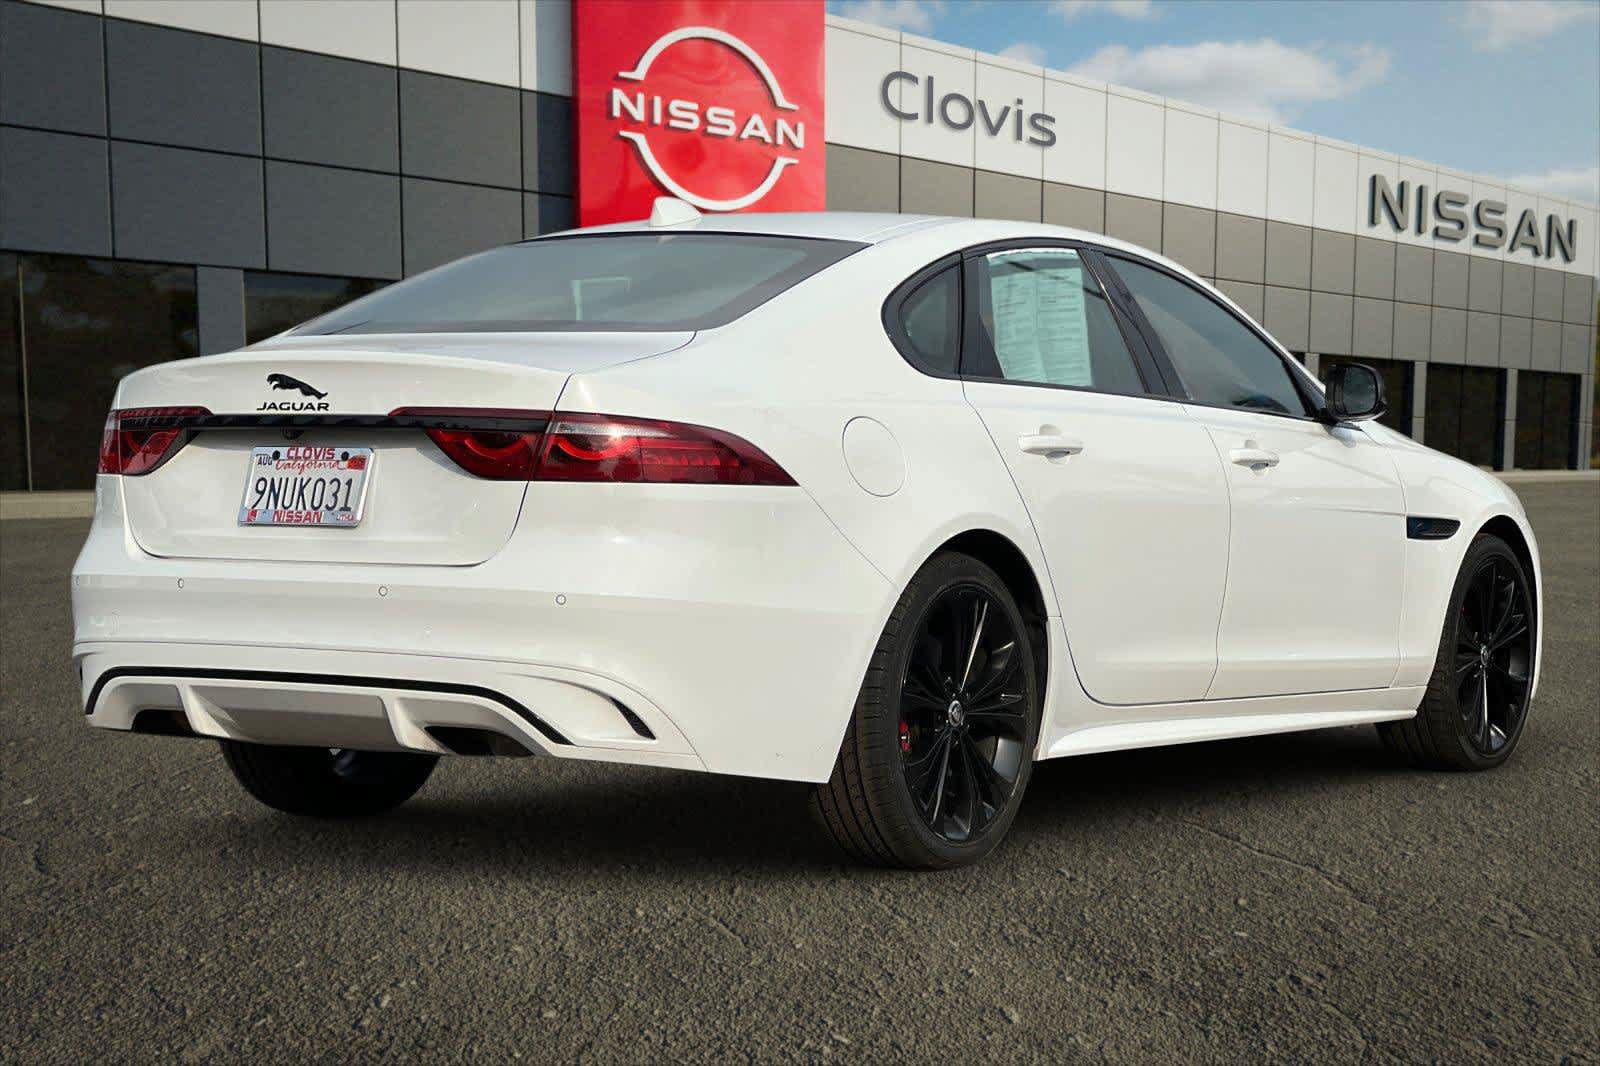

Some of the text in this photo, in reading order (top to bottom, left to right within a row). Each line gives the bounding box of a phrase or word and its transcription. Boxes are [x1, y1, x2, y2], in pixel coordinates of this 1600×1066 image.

[612, 88, 805, 148] NISSAN
[881, 71, 1057, 147] Clovis
[1369, 173, 1578, 263] NISSAN
[256, 401, 330, 412] JAGUAR
[257, 457, 273, 466] AUG
[286, 447, 336, 460] CLOVIS
[251, 477, 353, 512] 9NUK031
[272, 511, 323, 524] NISSAN
